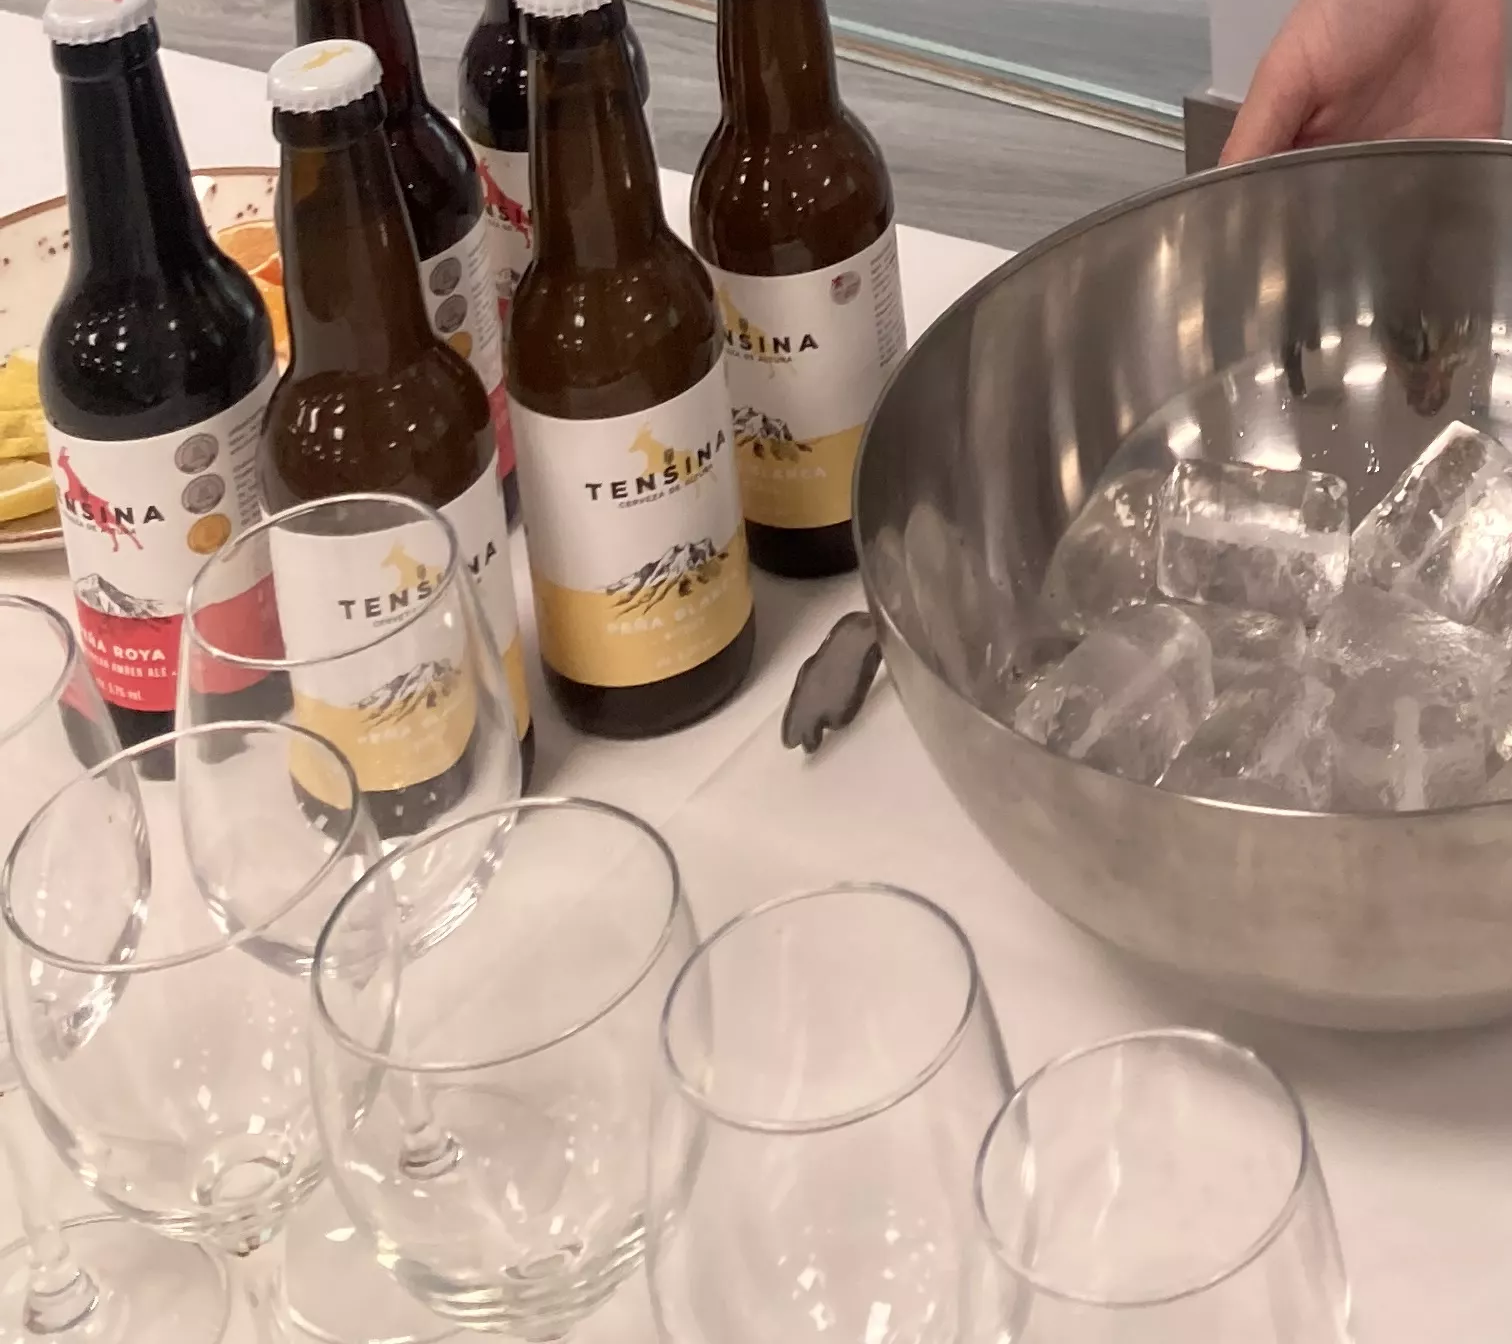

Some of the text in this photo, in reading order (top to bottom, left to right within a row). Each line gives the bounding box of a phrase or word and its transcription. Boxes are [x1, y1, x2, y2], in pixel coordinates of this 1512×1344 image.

[724, 329, 820, 354] NSINA
[585, 429, 726, 501] TENSINA
[63, 490, 165, 525] NSINA
[112, 644, 167, 662] ROYA
